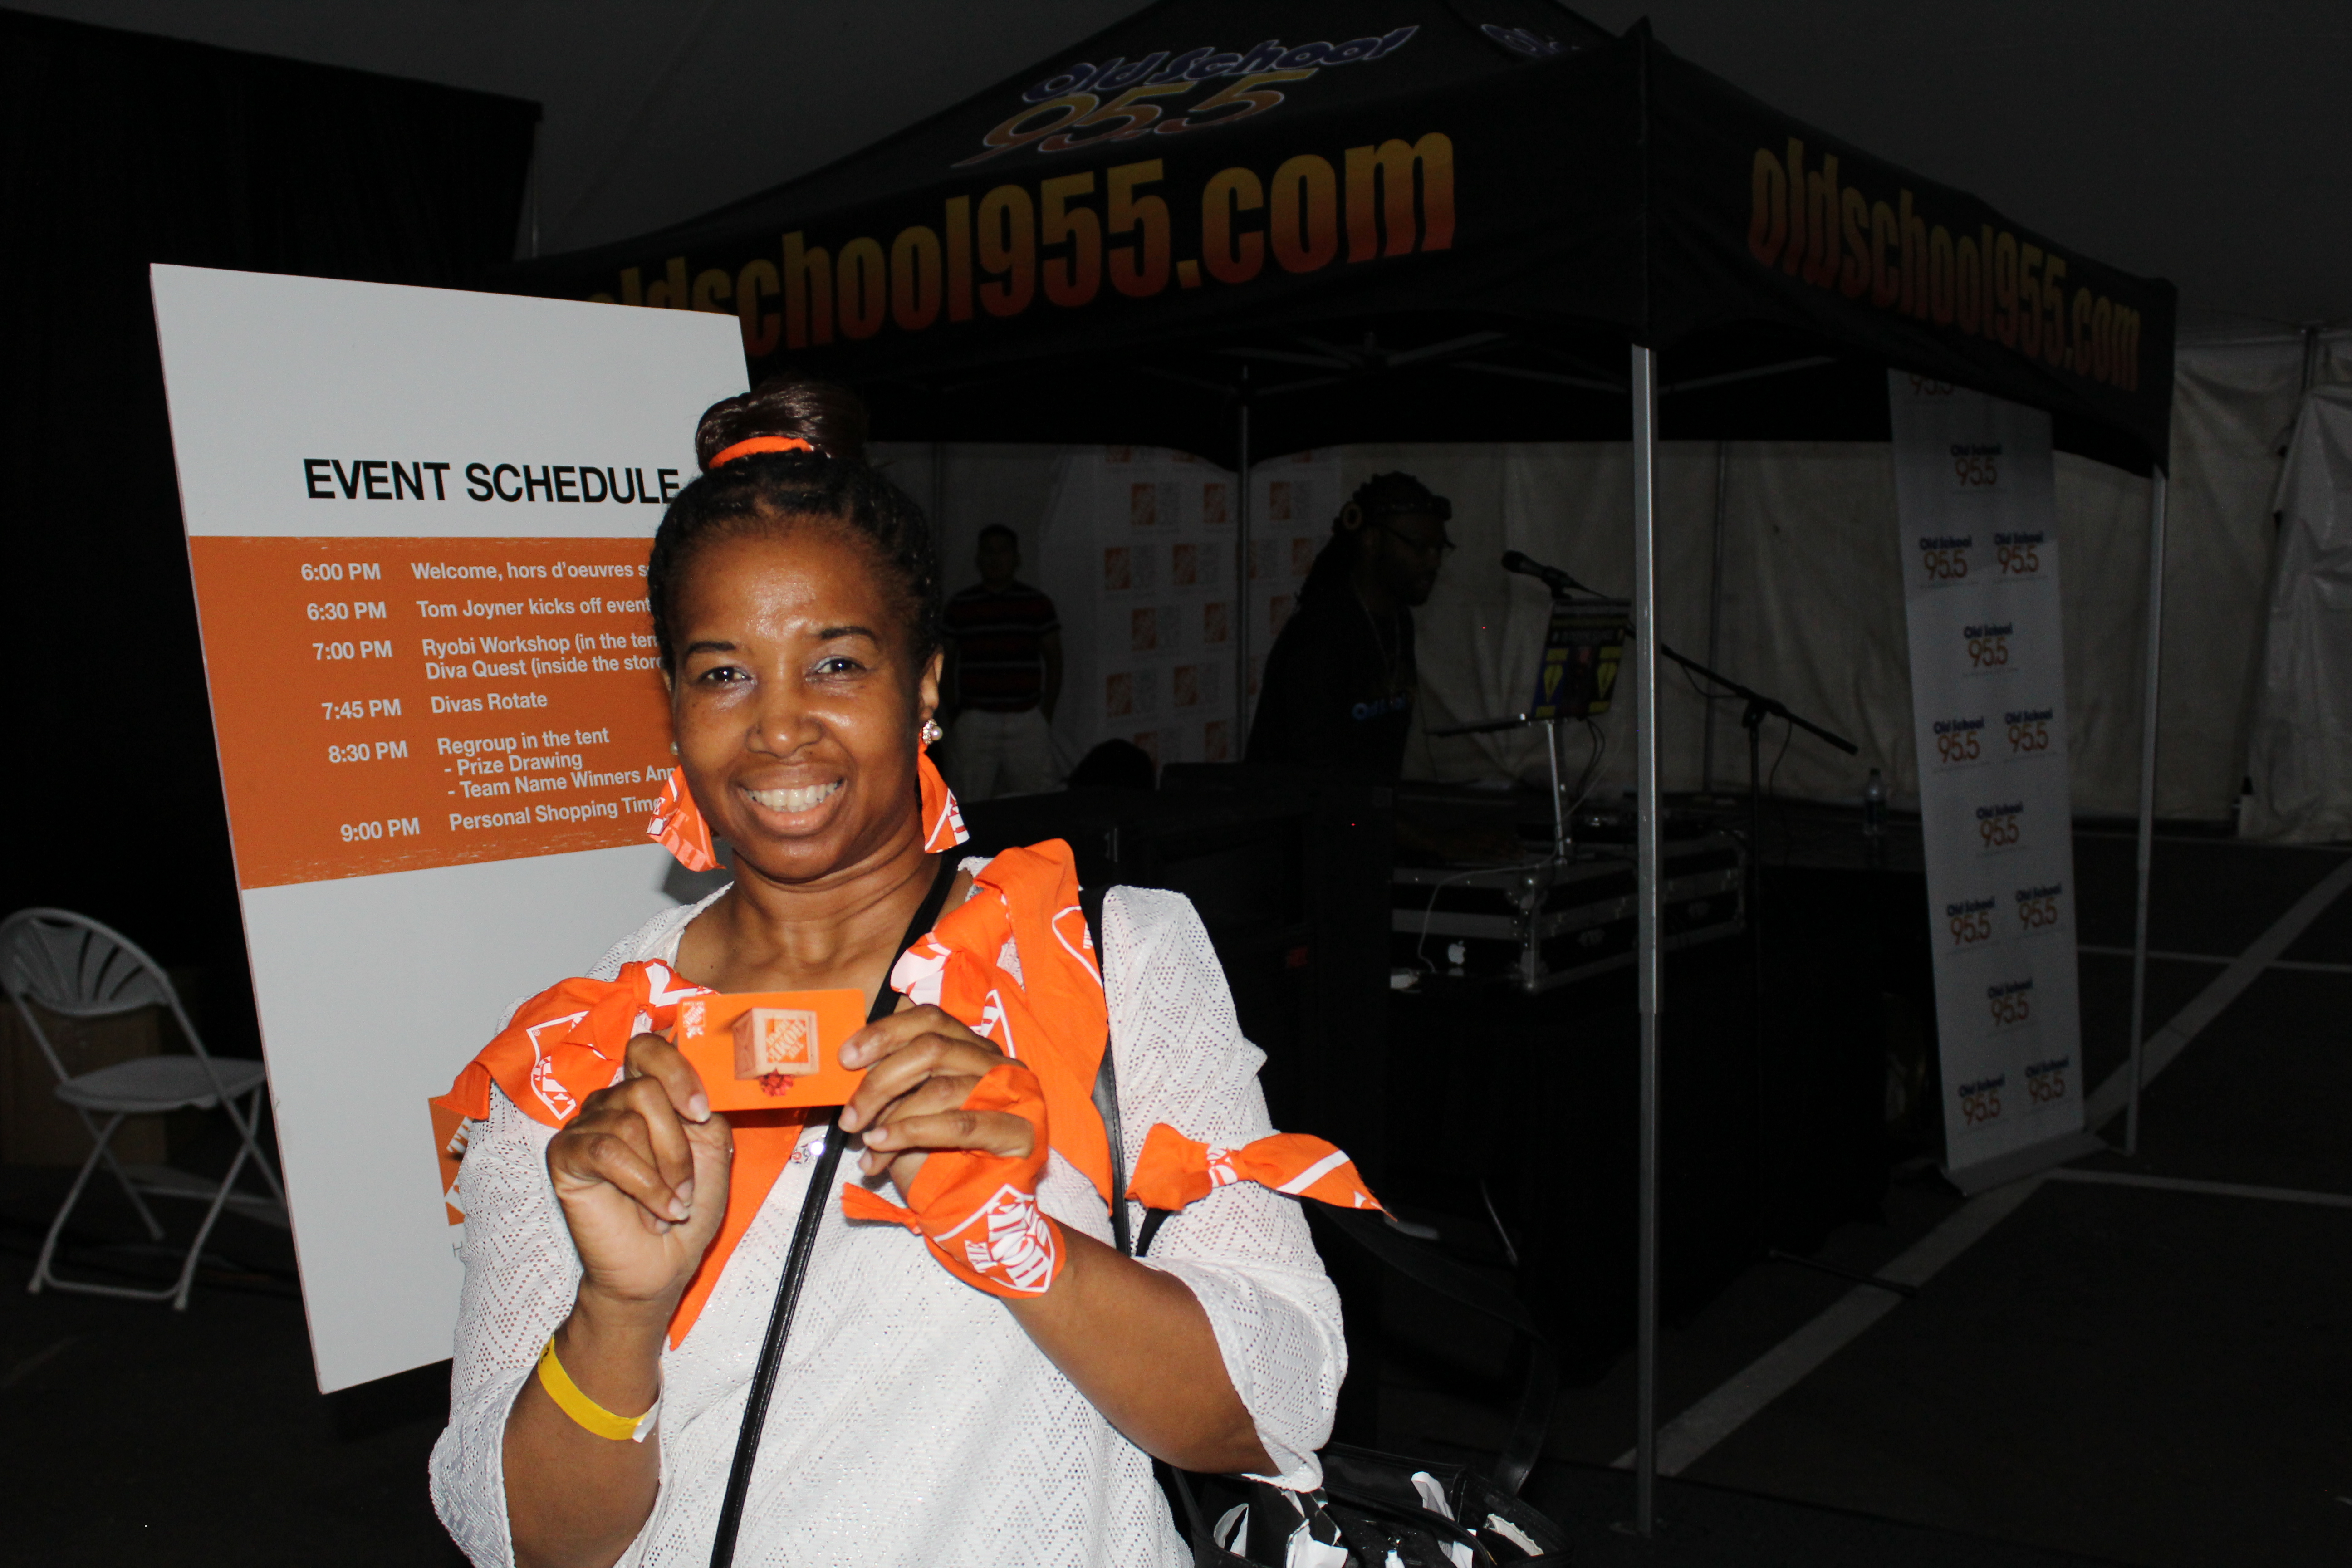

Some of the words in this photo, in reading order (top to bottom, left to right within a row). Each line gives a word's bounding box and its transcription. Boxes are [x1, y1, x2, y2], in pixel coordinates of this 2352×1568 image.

[950, 68, 1319, 169] 95.5
[586, 132, 1455, 358] chool955.com
[1748, 135, 2141, 392] oldschool955.com
[303, 458, 451, 501] EVENT
[465, 462, 681, 505] SCHEDULE
[1955, 457, 1996, 486] 95.5
[301, 563, 343, 581] 6:00
[348, 563, 381, 580] PM
[411, 562, 503, 581] Welcome,
[507, 562, 547, 578] hors
[1924, 549, 1967, 579] 95.5
[1998, 545, 2039, 574] 95.5
[307, 602, 349, 621] 6:30
[354, 601, 387, 619] PM
[416, 600, 458, 617] Tom
[462, 599, 524, 620] Joyner
[529, 598, 575, 615] kicks
[580, 597, 602, 614] off
[312, 642, 355, 660] 7:00
[360, 640, 393, 658] PM
[422, 637, 476, 659] Ryobi
[479, 635, 571, 654] Workshop
[575, 633, 596, 653] (in
[599, 633, 627, 649] the
[630, 632, 657, 648] ten
[1969, 636, 2008, 667] 95.5
[426, 662, 468, 680] Diva
[472, 659, 527, 678] Quest
[531, 656, 588, 678] (inside
[592, 655, 619, 671] the
[321, 701, 364, 720] 7:45
[369, 698, 402, 717] PM
[431, 696, 484, 714] Divas
[487, 692, 548, 710] Rotate
[328, 743, 371, 763] 8:30
[375, 740, 408, 760] PM
[437, 737, 518, 757] Regroup
[521, 732, 539, 749] in
[542, 730, 571, 747] the
[574, 727, 610, 745] tent
[1938, 731, 1980, 763] 95.5
[2008, 723, 2049, 753] 95.5
[457, 757, 504, 776] Prize
[509, 751, 583, 772] Drawing
[459, 780, 510, 798] Team
[515, 775, 567, 794] Name
[570, 770, 641, 788] Winners
[646, 765, 676, 781] Ann
[340, 821, 383, 842] 9:00
[387, 817, 421, 837] PM
[449, 806, 531, 831] Personal
[535, 800, 618, 823] Shopping
[1980, 816, 2019, 848] 95.5
[1951, 911, 1991, 945] 95.5
[2019, 898, 2058, 930] 95.5
[1991, 993, 2029, 1026] 95.5
[2028, 1071, 2065, 1104] 95.5
[1962, 1090, 2001, 1125] 95.5
